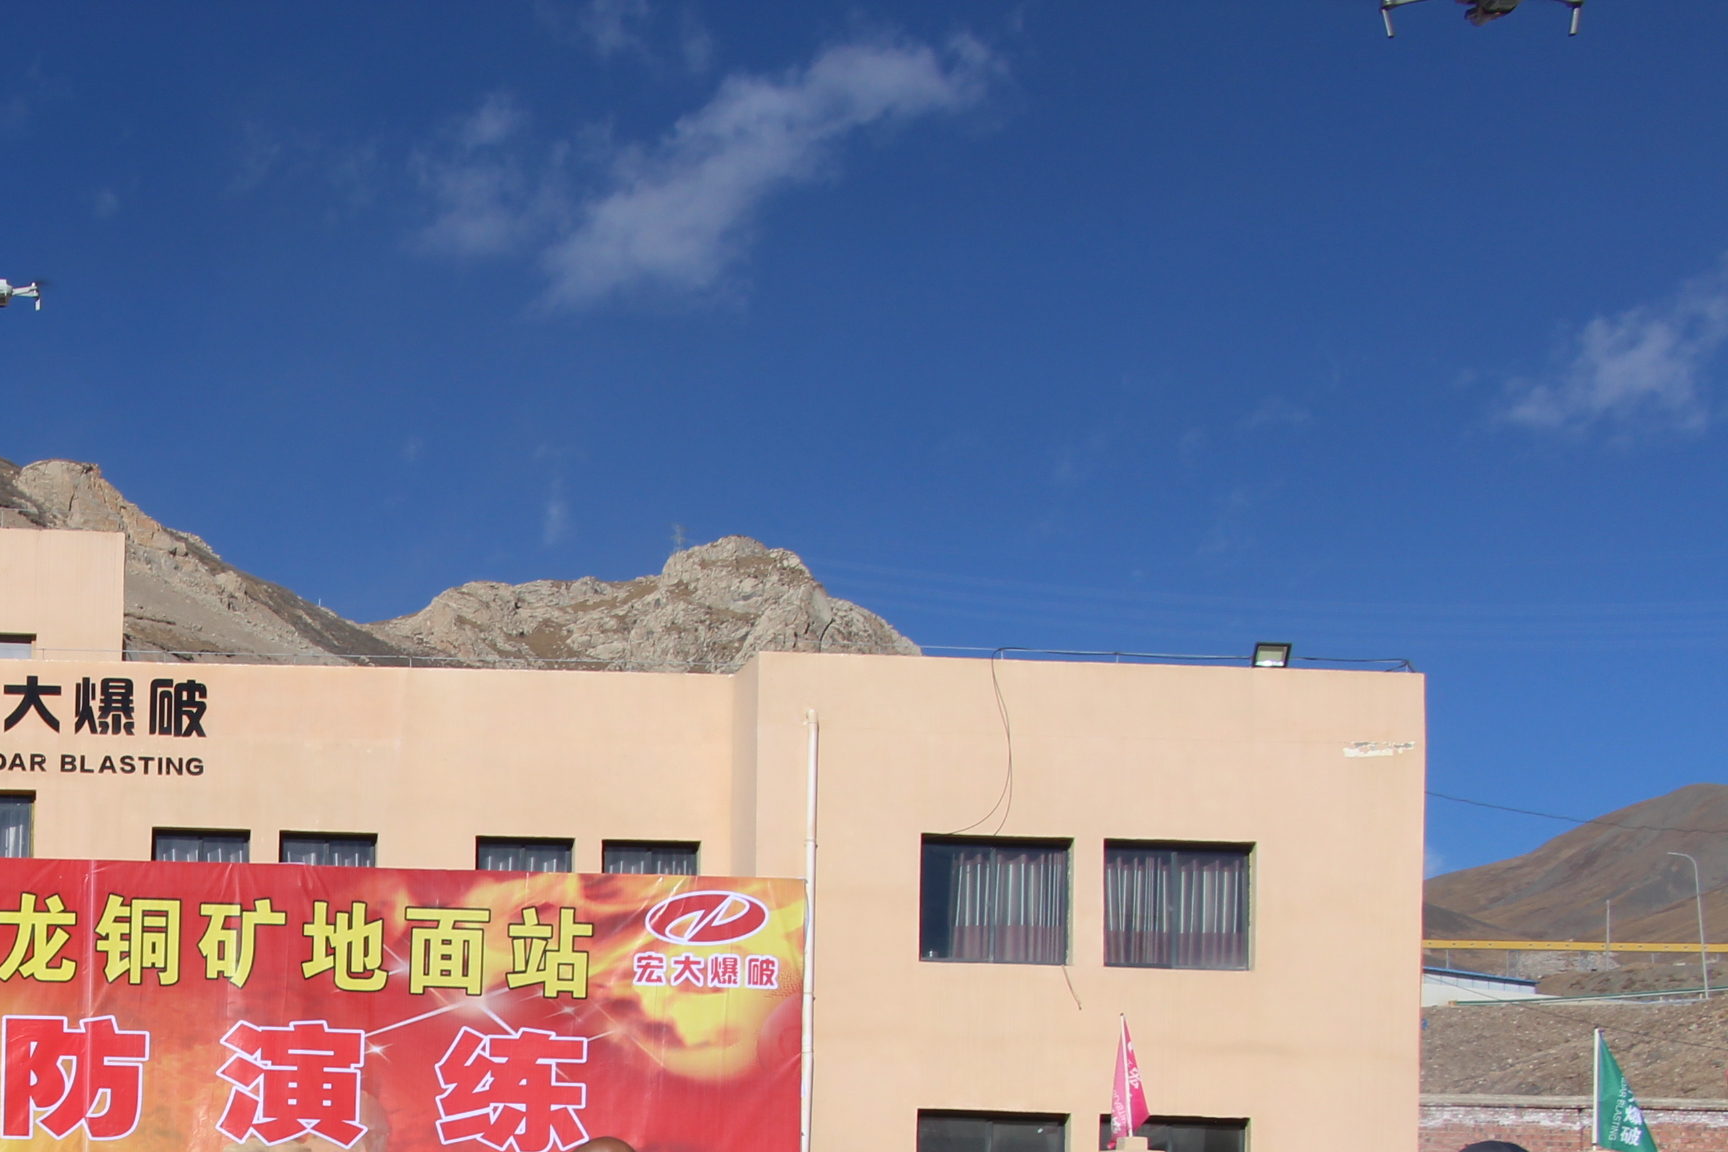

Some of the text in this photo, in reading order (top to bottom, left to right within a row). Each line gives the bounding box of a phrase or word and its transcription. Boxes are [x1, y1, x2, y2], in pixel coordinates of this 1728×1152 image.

[60, 754, 205, 776] BLASTING
[633, 953, 779, 990] 宏大爆破
[1608, 1099, 1626, 1141] BLASTING
